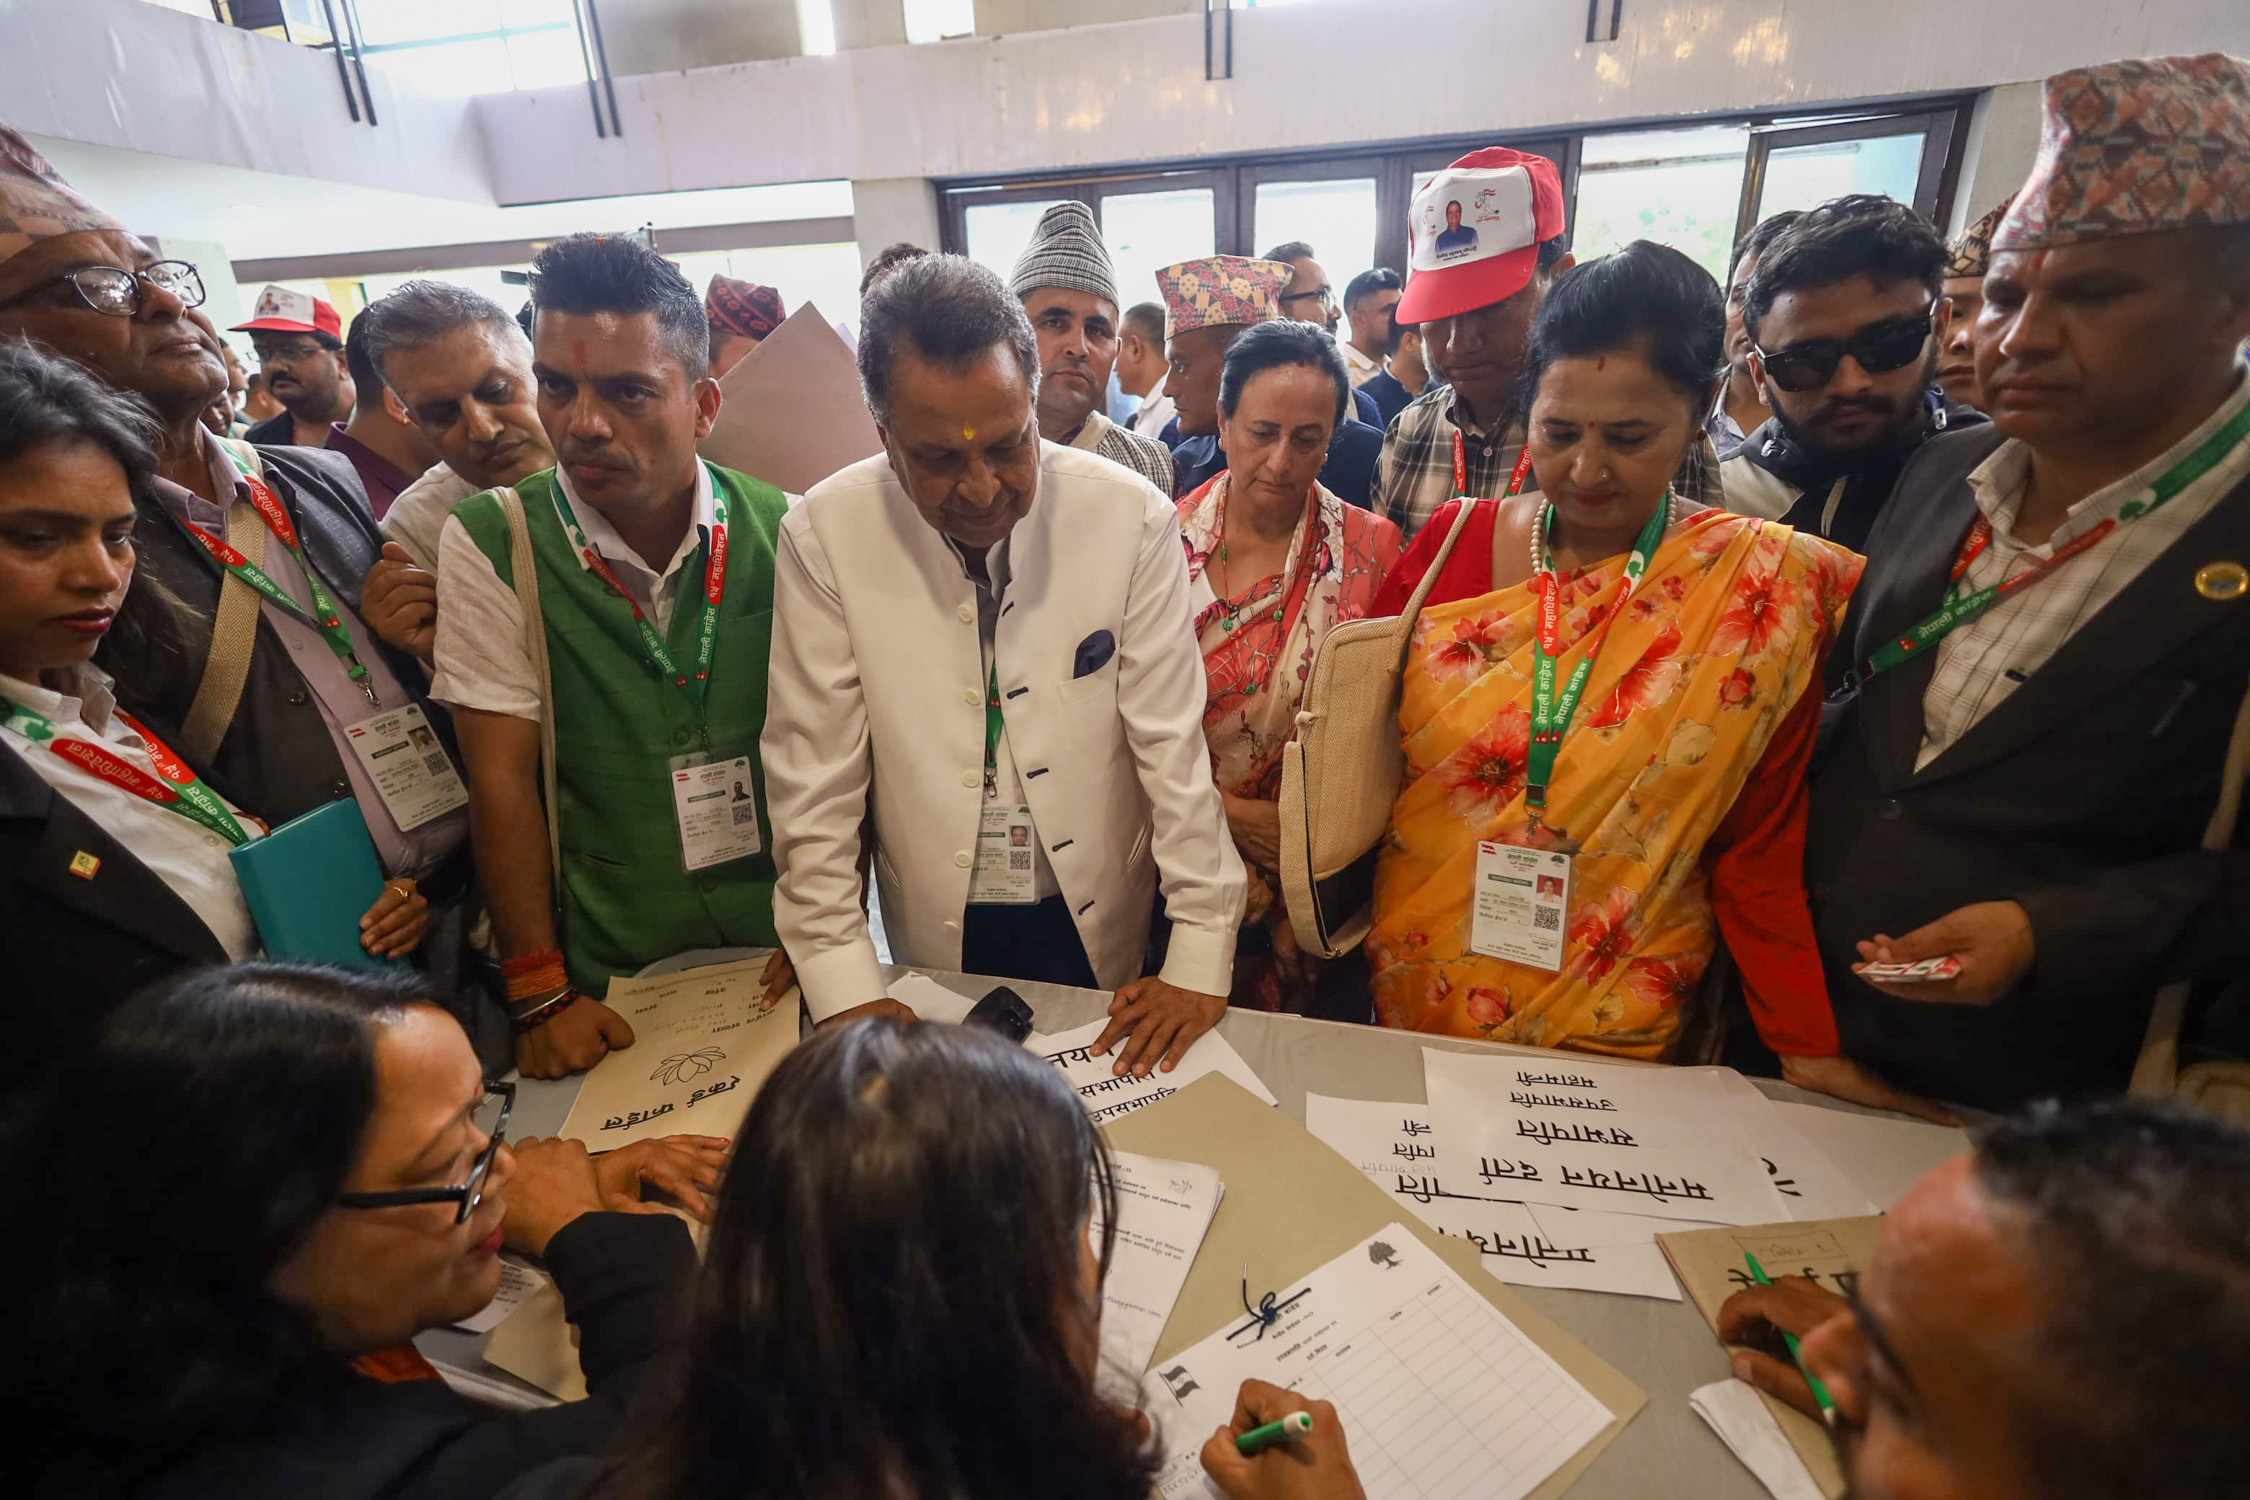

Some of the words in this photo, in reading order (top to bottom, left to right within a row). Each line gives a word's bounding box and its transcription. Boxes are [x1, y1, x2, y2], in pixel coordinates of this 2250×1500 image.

[711, 532, 725, 580] महाधिवेशन
[1543, 580, 1557, 629] महाधिवेशन
[703, 607, 716, 634] कांग्रेस
[1917, 611, 1953, 639] नेपाली
[654, 649, 677, 674] नेपाली
[698, 637, 711, 664] नेपाली
[1538, 660, 1552, 690] कांग्रेस
[1535, 694, 1549, 724] नेपाली
[1553, 694, 1575, 724] नेपाली
[64, 742, 141, 786] महाधिवेशन
[1516, 1071, 1598, 1088] महामन्त्री
[1509, 1092, 1618, 1112] उपसभापति
[1516, 1119, 1639, 1146] सभापति
[1479, 1157, 1543, 1185] दर्ता
[1560, 1165, 1714, 1204] मनोनयन
